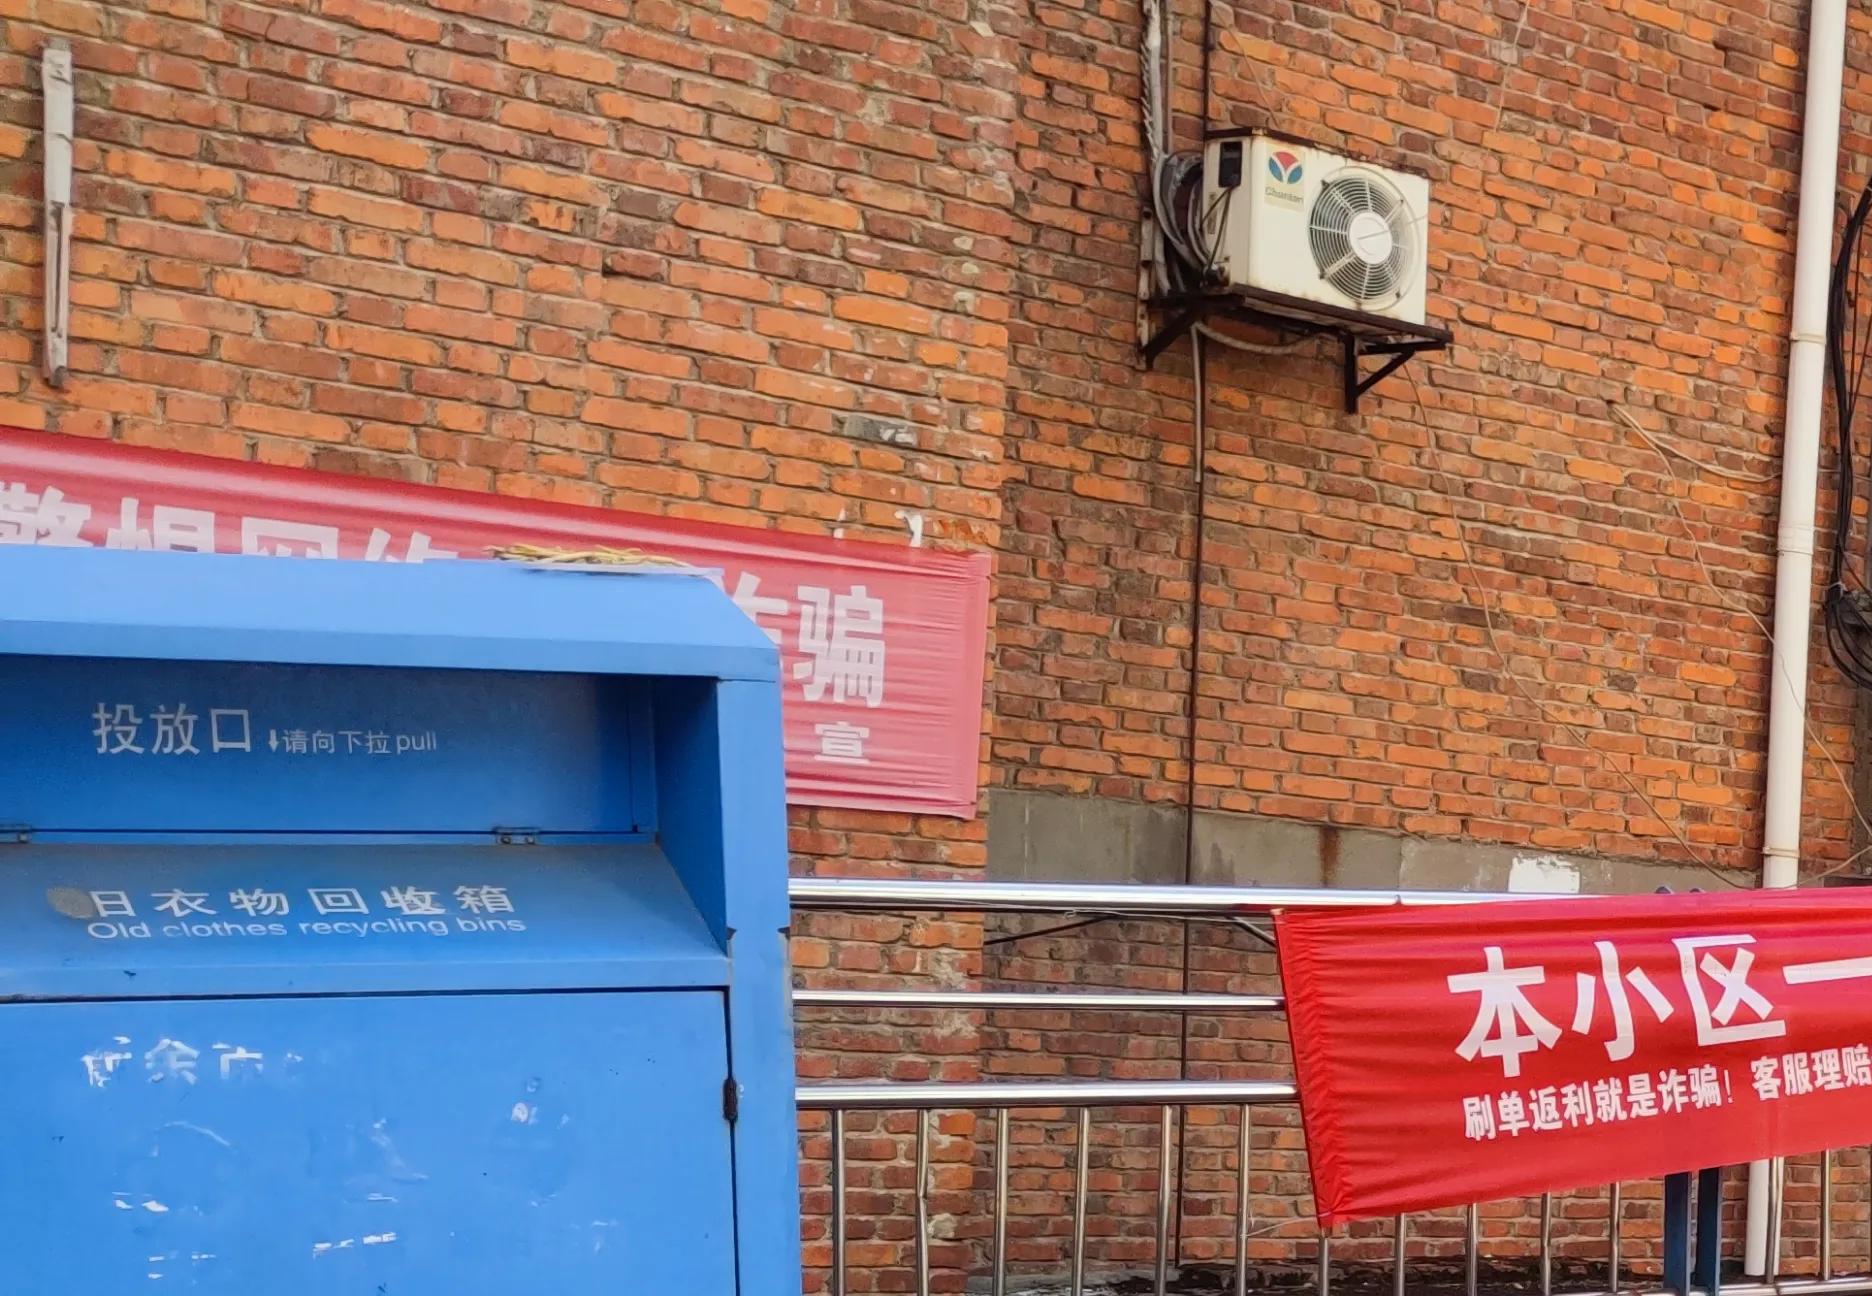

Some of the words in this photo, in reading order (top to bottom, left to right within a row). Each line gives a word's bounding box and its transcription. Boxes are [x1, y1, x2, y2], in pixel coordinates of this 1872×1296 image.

[92, 702, 251, 755] 投放口
[283, 729, 392, 754] 请向下拉
[396, 731, 437, 755] pull
[87, 920, 152, 939] Old
[163, 919, 288, 938] clothes
[300, 917, 449, 938] recycling
[456, 916, 527, 933] bins
